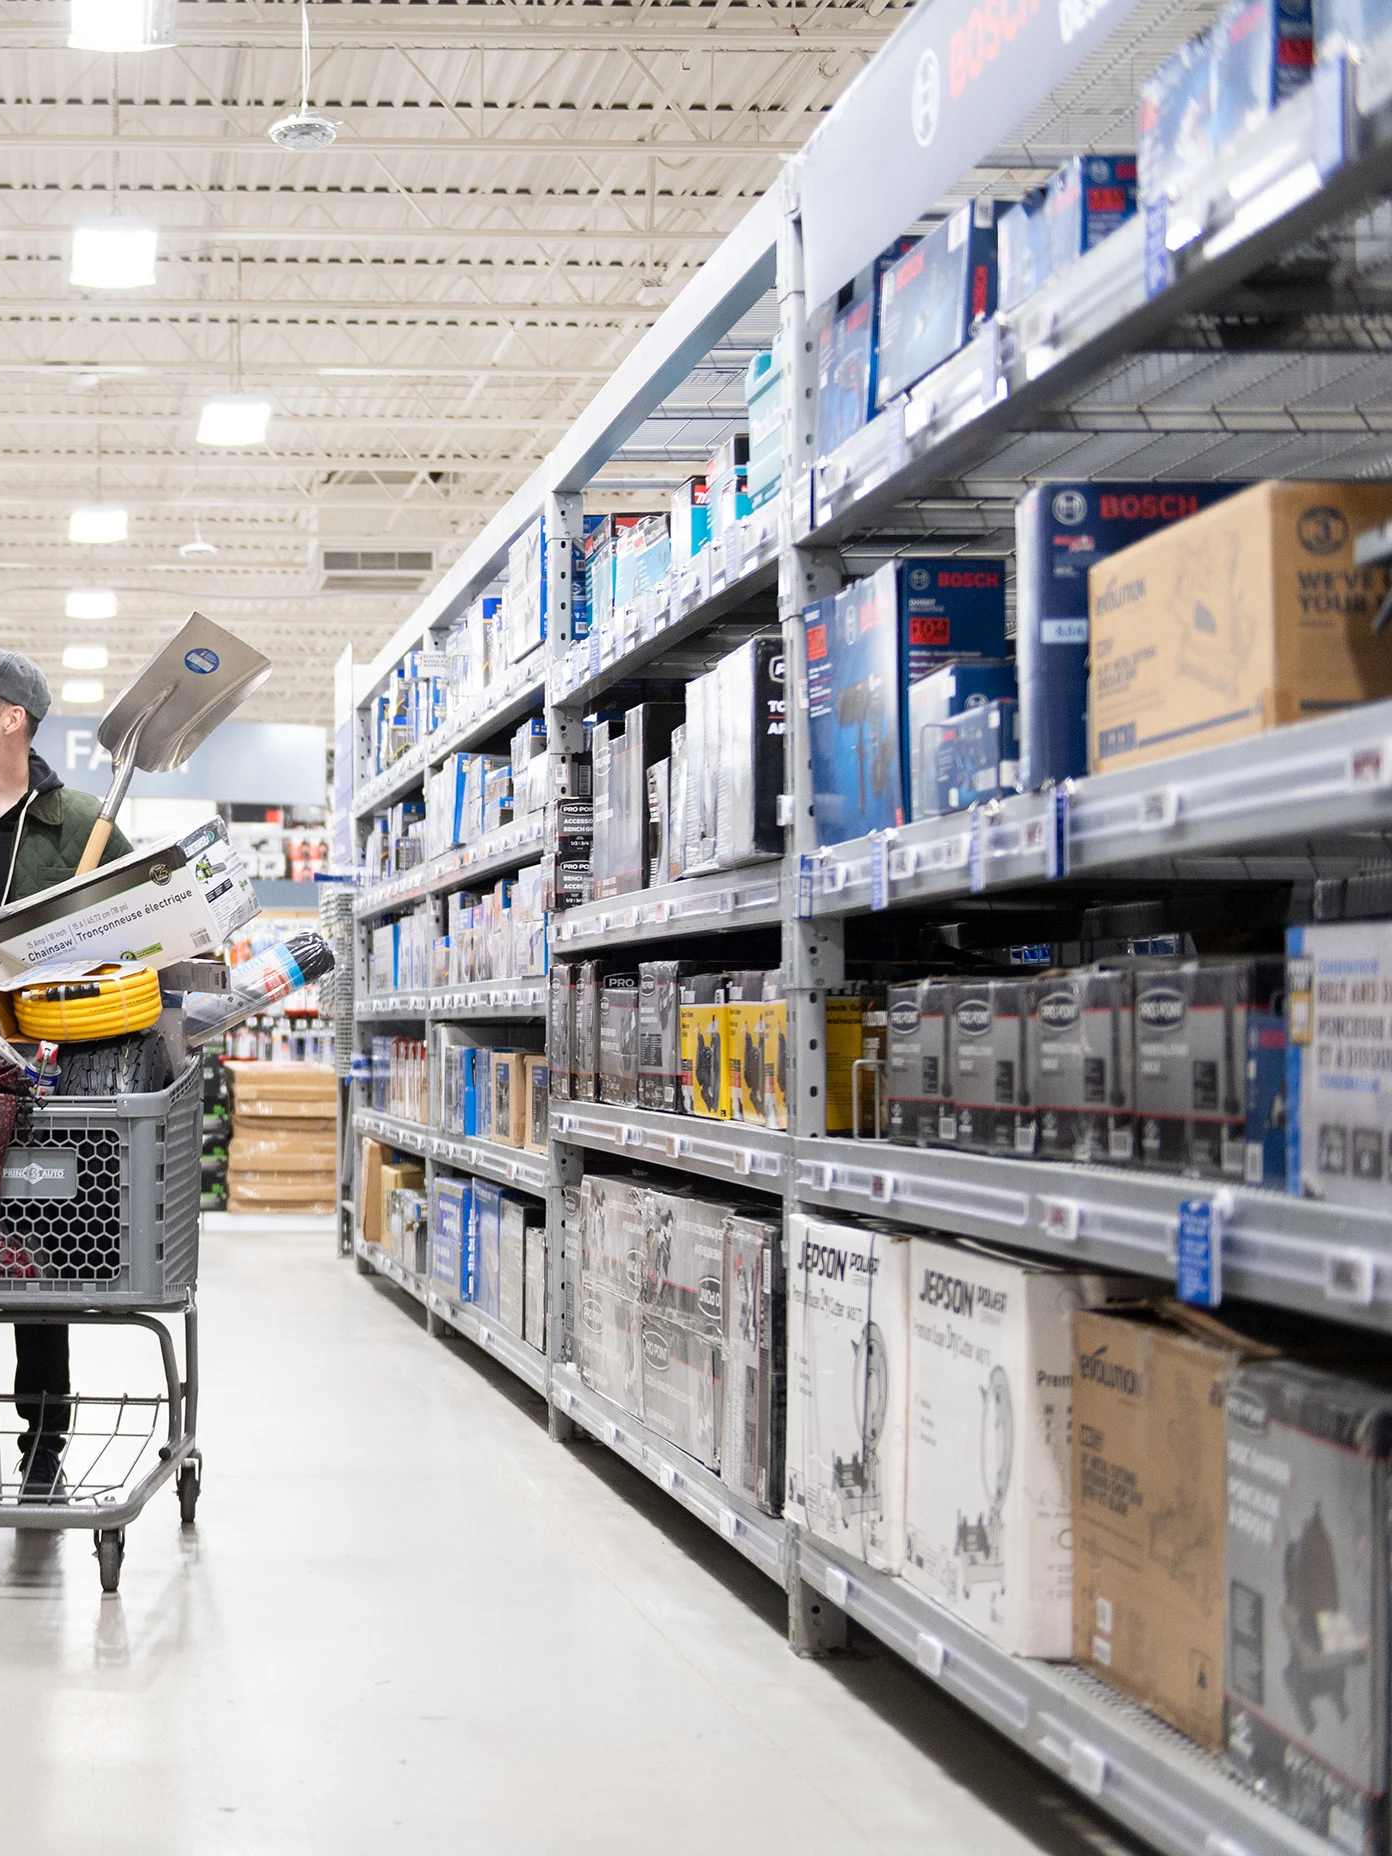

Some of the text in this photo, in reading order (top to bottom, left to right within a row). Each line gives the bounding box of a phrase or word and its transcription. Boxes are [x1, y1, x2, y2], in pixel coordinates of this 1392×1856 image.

[1099, 494, 1199, 520] BOSCH
[937, 572, 1000, 588] BOSCH
[76, 890, 193, 943] Tronçonneuse électrique
[28, 938, 73, 962] Chainsaw
[34, 938, 46, 947] Amp
[608, 978, 635, 988] PRO
[3, 1168, 64, 1179] PRINCESS AUTO
[797, 1240, 881, 1282] JEPSON POWER
[919, 1268, 1008, 1319] JEPSON POWER
